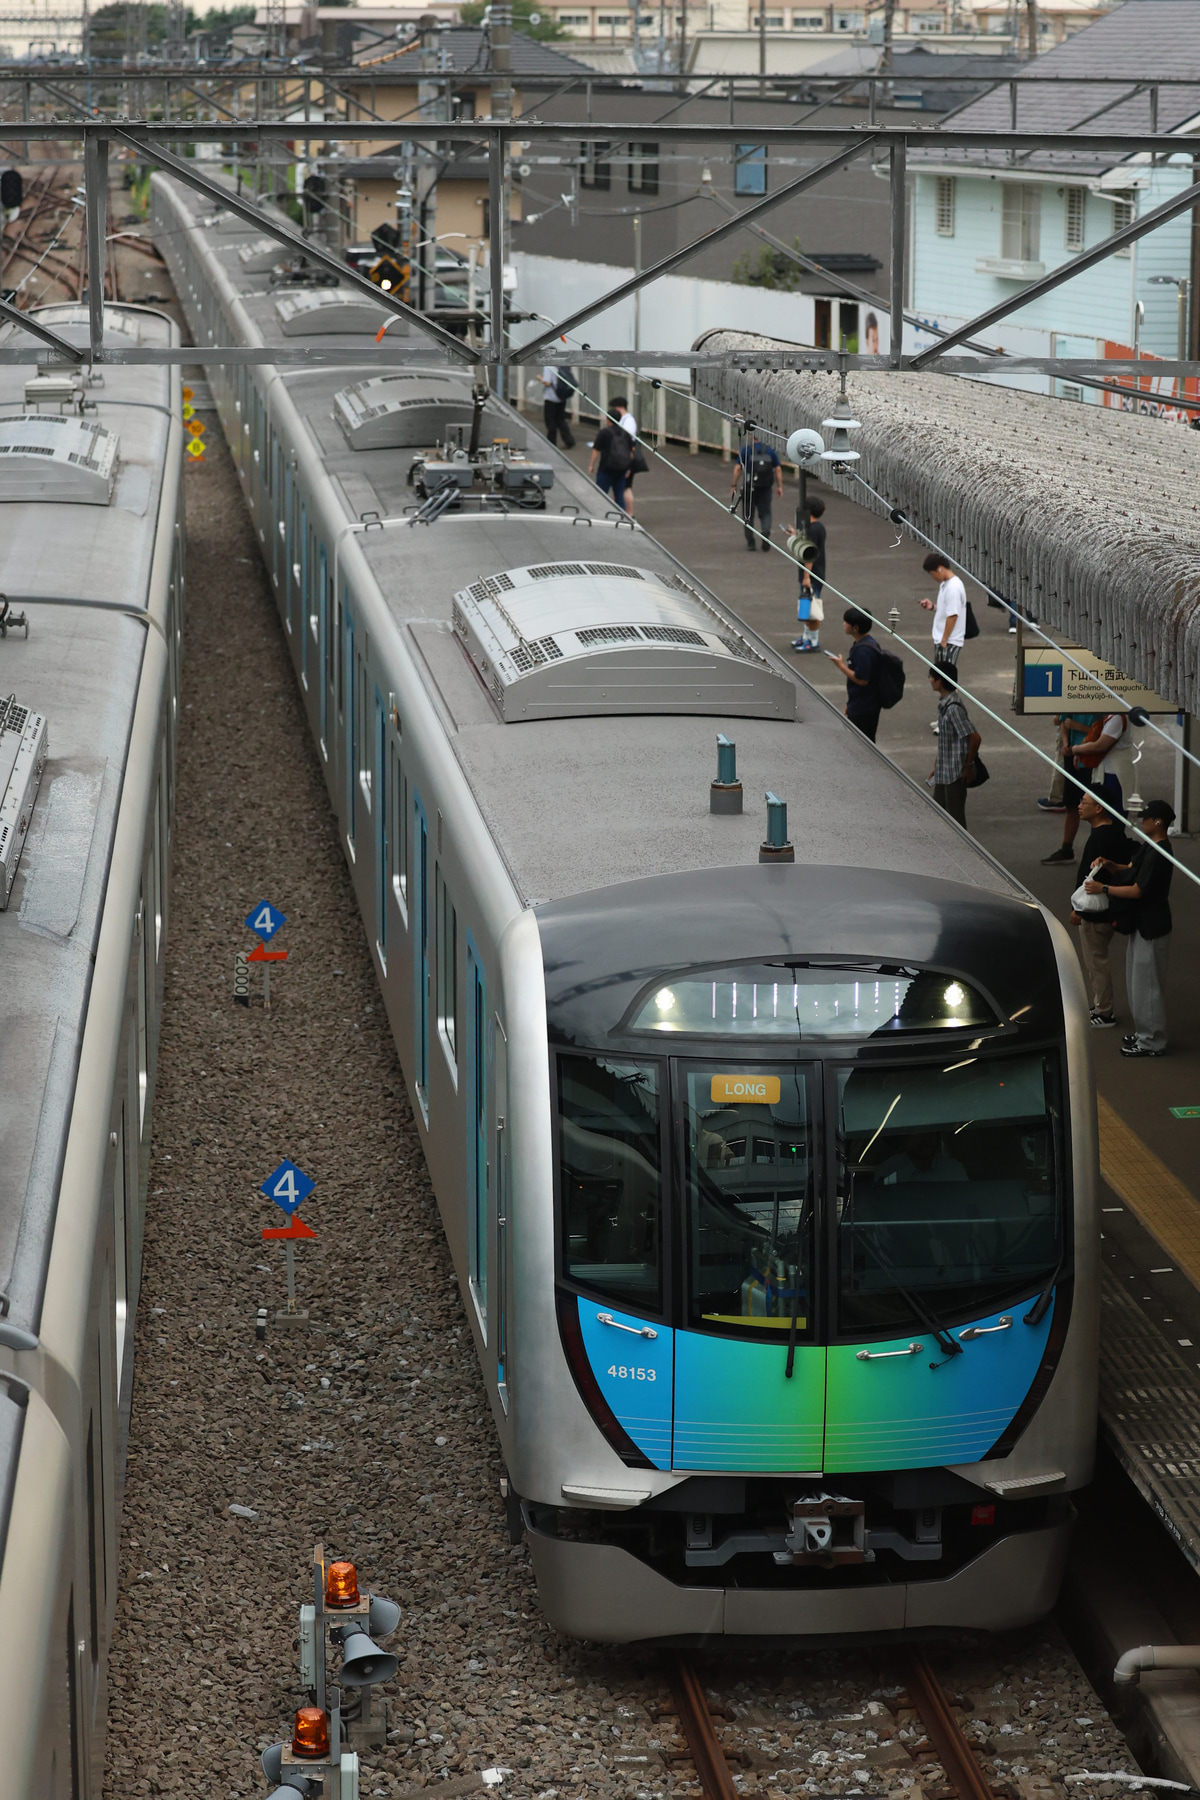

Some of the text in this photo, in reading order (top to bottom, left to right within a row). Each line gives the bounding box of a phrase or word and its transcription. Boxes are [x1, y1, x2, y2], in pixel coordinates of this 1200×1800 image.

[1045, 670, 1053, 693] 1
[1079, 684, 1141, 692] Shimo-amaguchi
[254, 907, 275, 933] 4
[235, 955, 249, 995] 2000
[725, 1083, 766, 1096] LONG
[273, 1170, 300, 1203] 4
[607, 1364, 657, 1382] 48153
